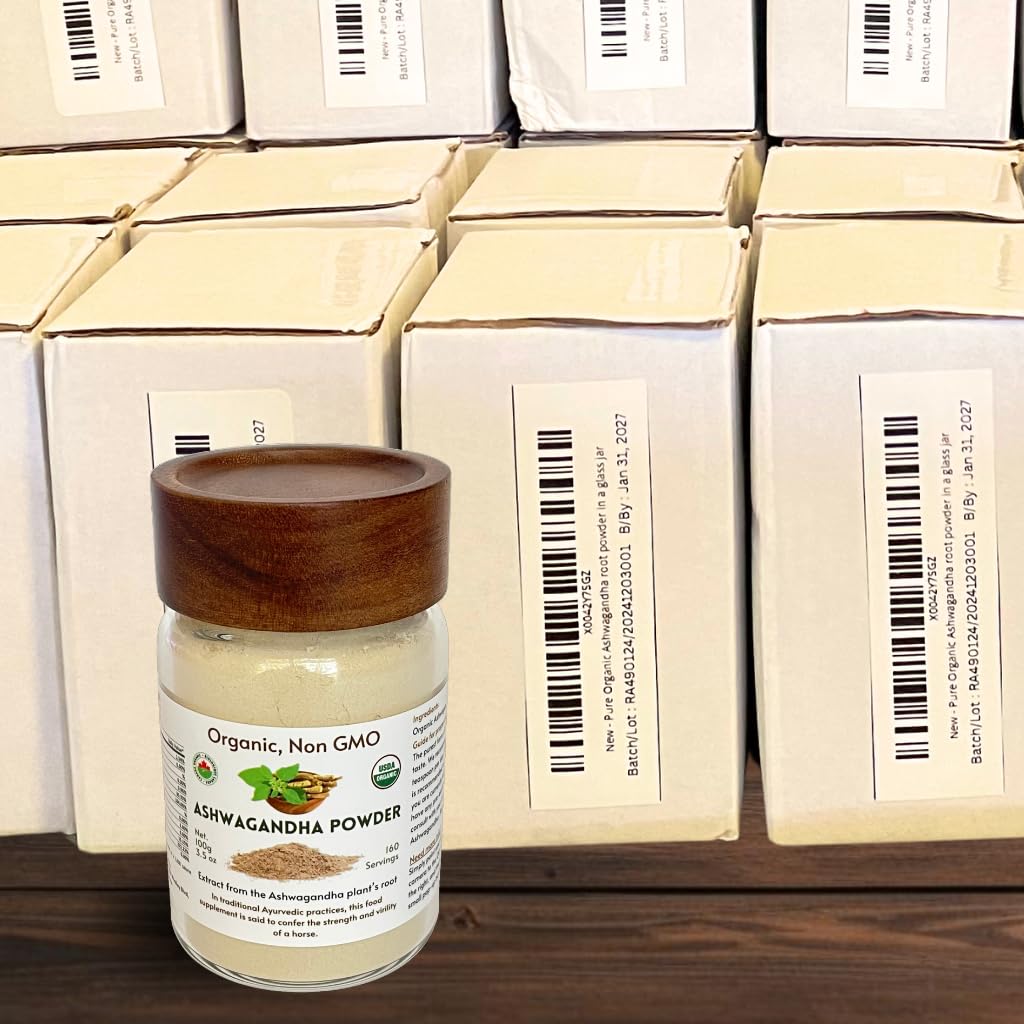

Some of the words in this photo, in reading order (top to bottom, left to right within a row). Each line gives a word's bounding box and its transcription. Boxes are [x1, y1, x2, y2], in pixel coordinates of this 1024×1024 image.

[397, 30, 408, 80] Batch/Lot
[920, 32, 931, 83] Batch/Lot
[614, 412, 628, 444] 2027
[959, 400, 972, 431] 2027
[252, 419, 265, 446] 027
[940, 432, 952, 447] jar
[961, 434, 974, 453] 31,
[616, 447, 629, 466] 31,
[941, 449, 953, 475] glass
[963, 456, 974, 480] Jan
[618, 469, 629, 493] Jan
[941, 486, 951, 497] in
[618, 503, 633, 534] B/By
[942, 499, 955, 539] powder
[962, 490, 977, 521] B/By
[943, 541, 953, 564] root
[945, 566, 958, 639] Ashwagandha
[964, 531, 979, 691] RA490124/20241203001
[619, 545, 635, 704] RA490124/20241203001
[947, 641, 959, 681] Organic
[948, 683, 958, 708] Pure
[949, 716, 959, 739] New
[970, 701, 982, 764] Batch/Lot
[207, 727, 283, 756] Organic,
[289, 738, 327, 754] Non
[333, 730, 381, 752] GMO
[626, 714, 638, 776] Batch/Lot
[376, 770, 398, 782] ORGANIC
[378, 761, 396, 773] USDA
[193, 801, 324, 835] ASHWAGANDHA
[330, 805, 401, 834] POWDER
[385, 841, 400, 854] 160
[365, 854, 400, 870] Servings
[197, 871, 224, 890] Extract
[226, 882, 248, 896] from
[250, 888, 266, 899] the
[268, 890, 344, 904] Ashwagandha
[381, 875, 398, 889] root
[199, 899, 238, 919] supplement
[239, 912, 246, 921] is
[247, 913, 266, 924] said
[267, 917, 276, 926] to
[277, 918, 305, 927] confer
[307, 918, 321, 927] the
[323, 914, 358, 927] strength
[359, 910, 375, 920] and
[376, 901, 397, 917] virility
[211, 892, 219, 902] In
[219, 896, 260, 913] traditional
[261, 906, 304, 918] Ayurvedic
[349, 902, 364, 912] this
[365, 896, 383, 909] food
[272, 929, 282, 938] of
[291, 929, 319, 938] horse.
